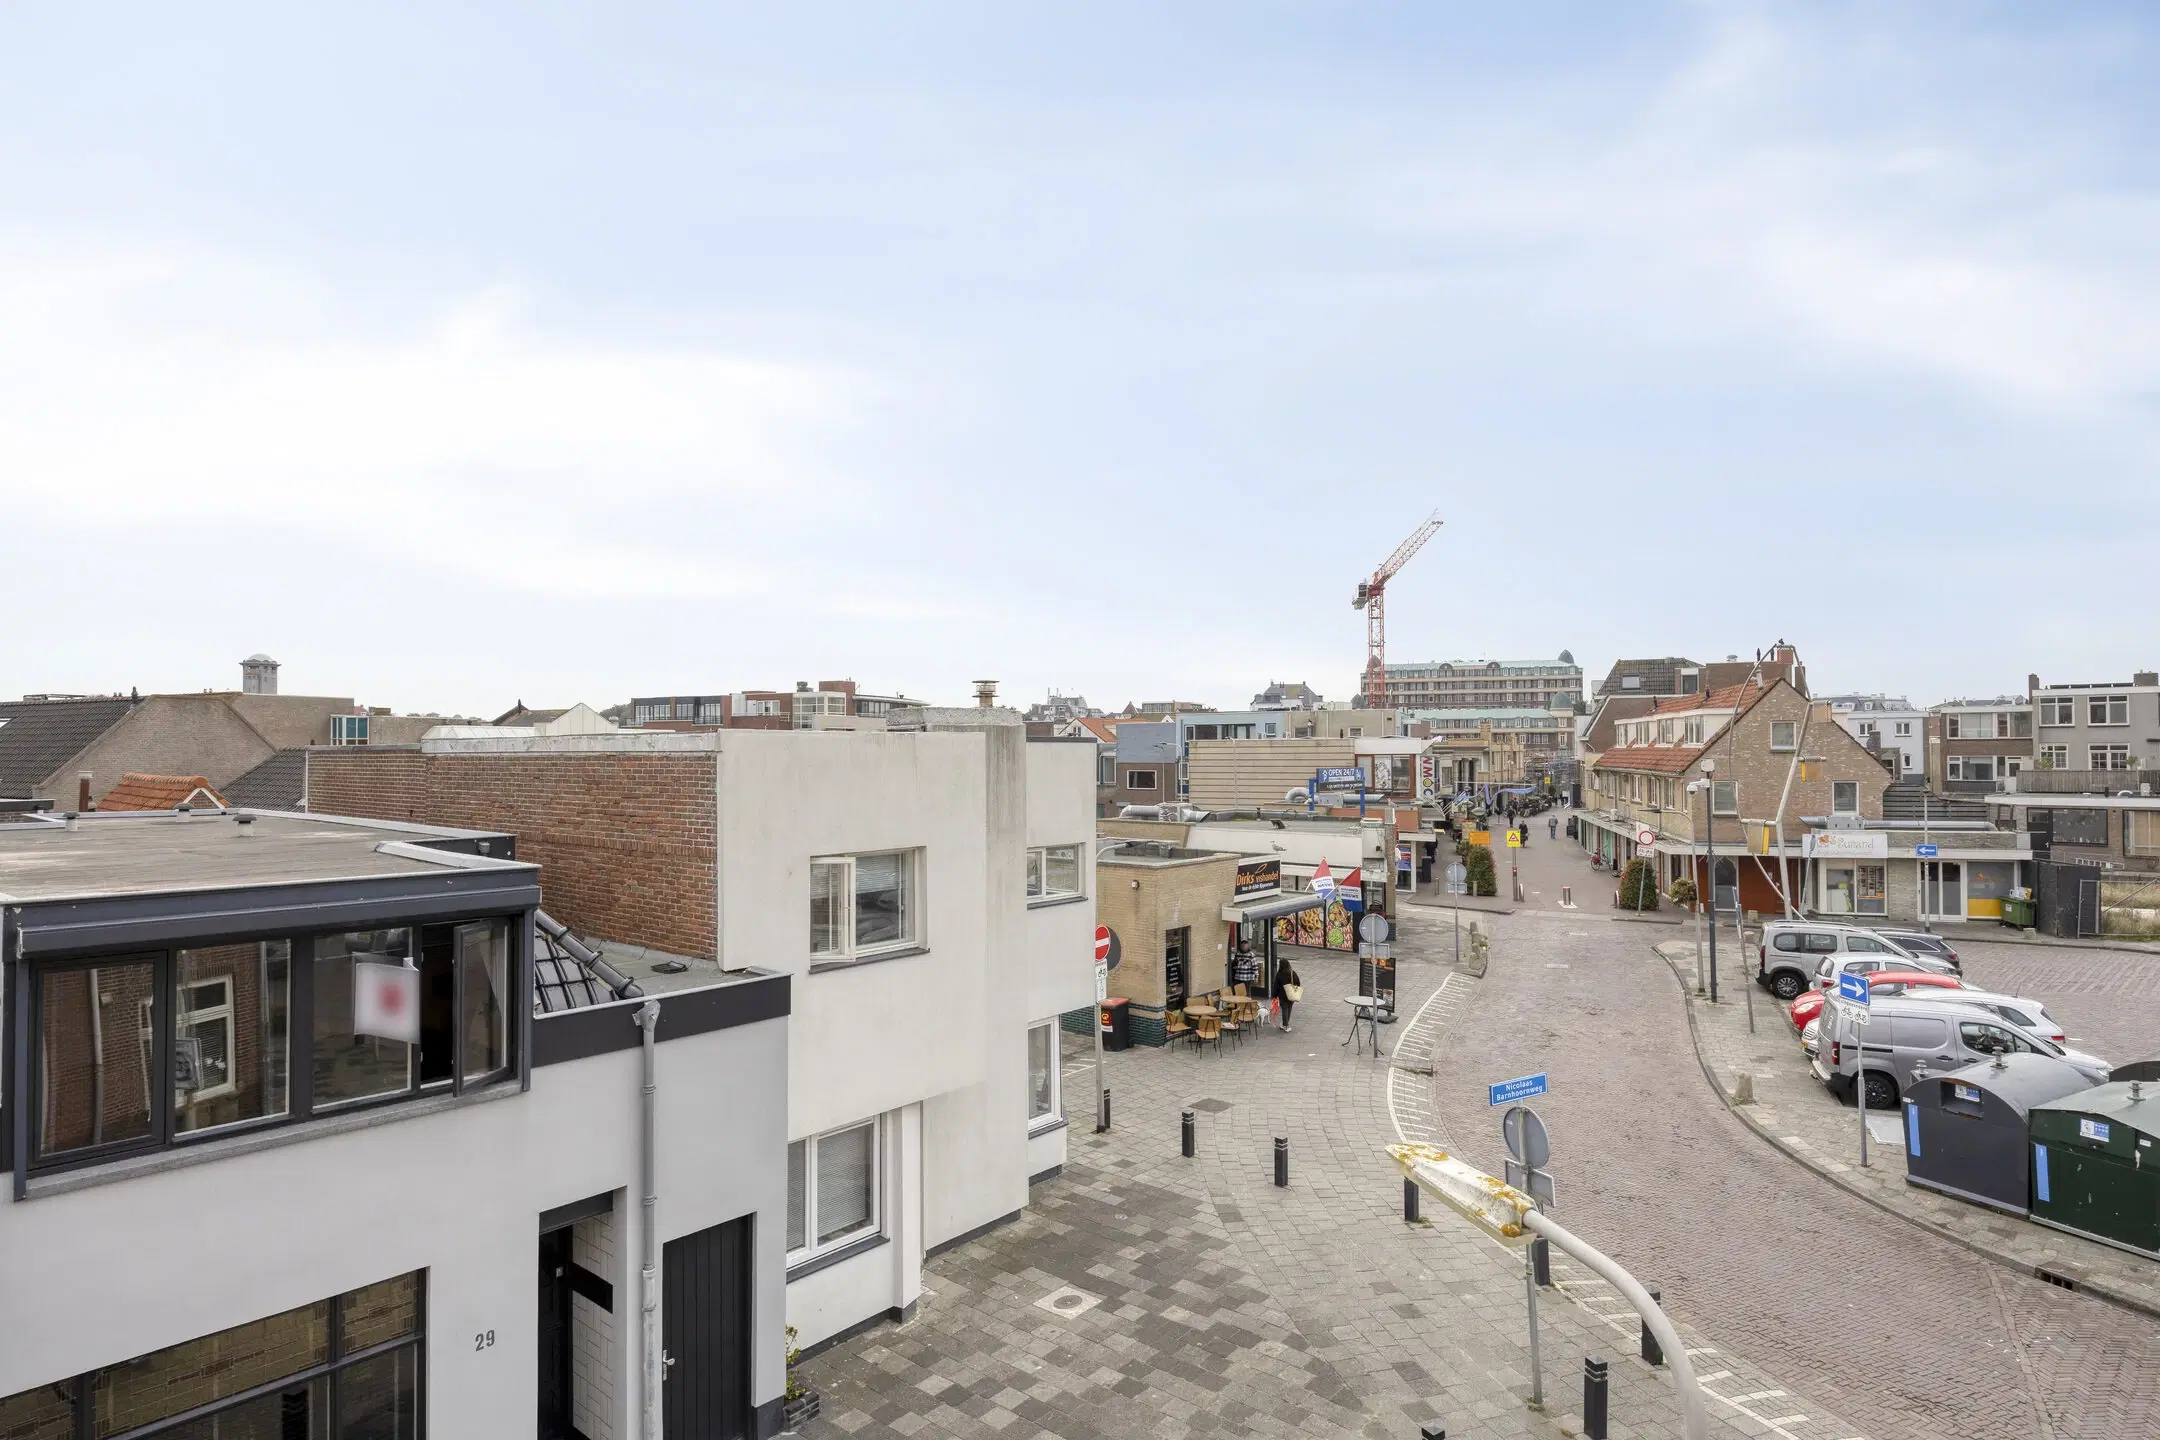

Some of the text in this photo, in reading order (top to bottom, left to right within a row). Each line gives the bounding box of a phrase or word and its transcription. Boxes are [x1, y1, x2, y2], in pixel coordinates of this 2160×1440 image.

[1343, 768, 1355, 776] 24/7
[1236, 872, 1254, 887] Dirks
[1255, 870, 1279, 883] vishandel
[1496, 1085, 1543, 1101] Barnhoornweg
[1505, 1080, 1533, 1091] Nicolaas
[475, 1329, 495, 1351] 29
